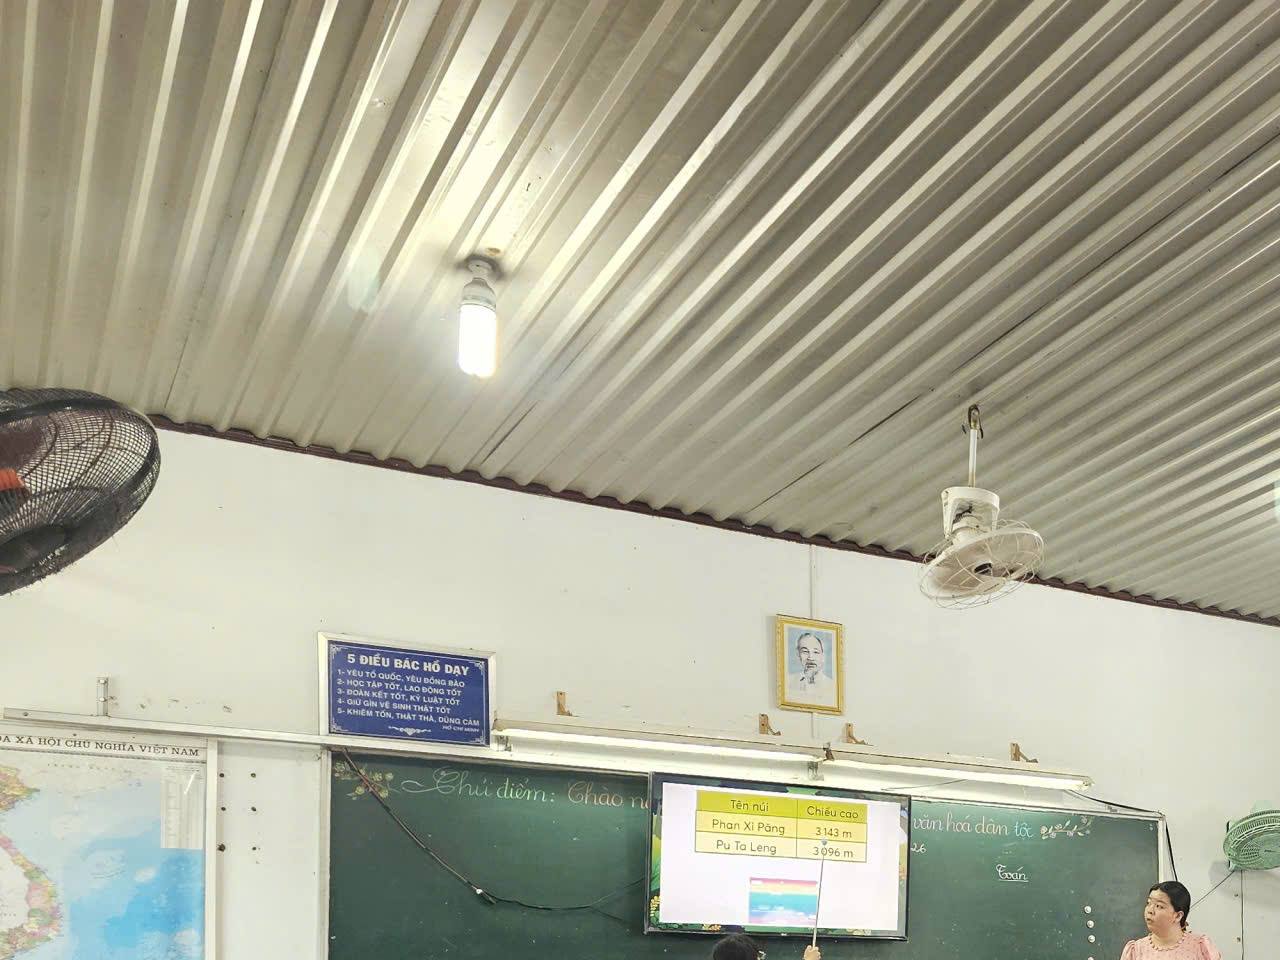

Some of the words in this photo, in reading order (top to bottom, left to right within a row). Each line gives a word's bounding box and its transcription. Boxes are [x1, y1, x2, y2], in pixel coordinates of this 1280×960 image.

[348, 654, 355, 664] 5
[359, 652, 390, 667] ĐIỀU
[394, 657, 419, 670] BÁC
[422, 660, 441, 673] HỒ
[444, 664, 469, 676] DẠY
[346, 679, 365, 688] HỌC
[422, 686, 445, 695] ĐỘNG
[446, 688, 462, 696] TỐT
[405, 675, 422, 683] YÊU
[423, 676, 447, 685] ĐỒNG
[448, 679, 465, 687] BÀO
[346, 688, 370, 697] ĐOÀN
[372, 689, 388, 698] KẾT
[423, 696, 444, 704] LUẬT
[445, 697, 460, 705] TỐT
[346, 697, 361, 705] GIỮ
[363, 699, 378, 707] GÌN
[412, 705, 434, 713] THẬT
[436, 705, 451, 714] TỐT
[347, 708, 373, 716] KHIÊM
[396, 712, 418, 720] THẬT
[439, 716, 461, 724] DŨNG
[462, 718, 480, 726] CẢM
[38, 737, 61, 747] HỘI
[95, 742, 135, 752] NGHĨA
[139, 743, 169, 754] VIỆT
[171, 748, 199, 756] NAM
[567, 780, 623, 806] Chào
[731, 799, 749, 810] Tên
[752, 801, 769, 812] núi
[807, 806, 837, 818] Chiều
[840, 810, 859, 819] cao
[712, 819, 740, 830] Phan
[744, 821, 755, 831] Xi
[757, 822, 785, 836] Păng
[843, 830, 852, 838] m
[913, 814, 943, 831] văn
[975, 816, 1009, 836] dân
[1014, 822, 1034, 840] tộc
[716, 840, 731, 850] Pu
[734, 840, 748, 851] Ta
[750, 841, 776, 856] Leng
[843, 850, 853, 858] m
[995, 863, 1028, 881] Toán
